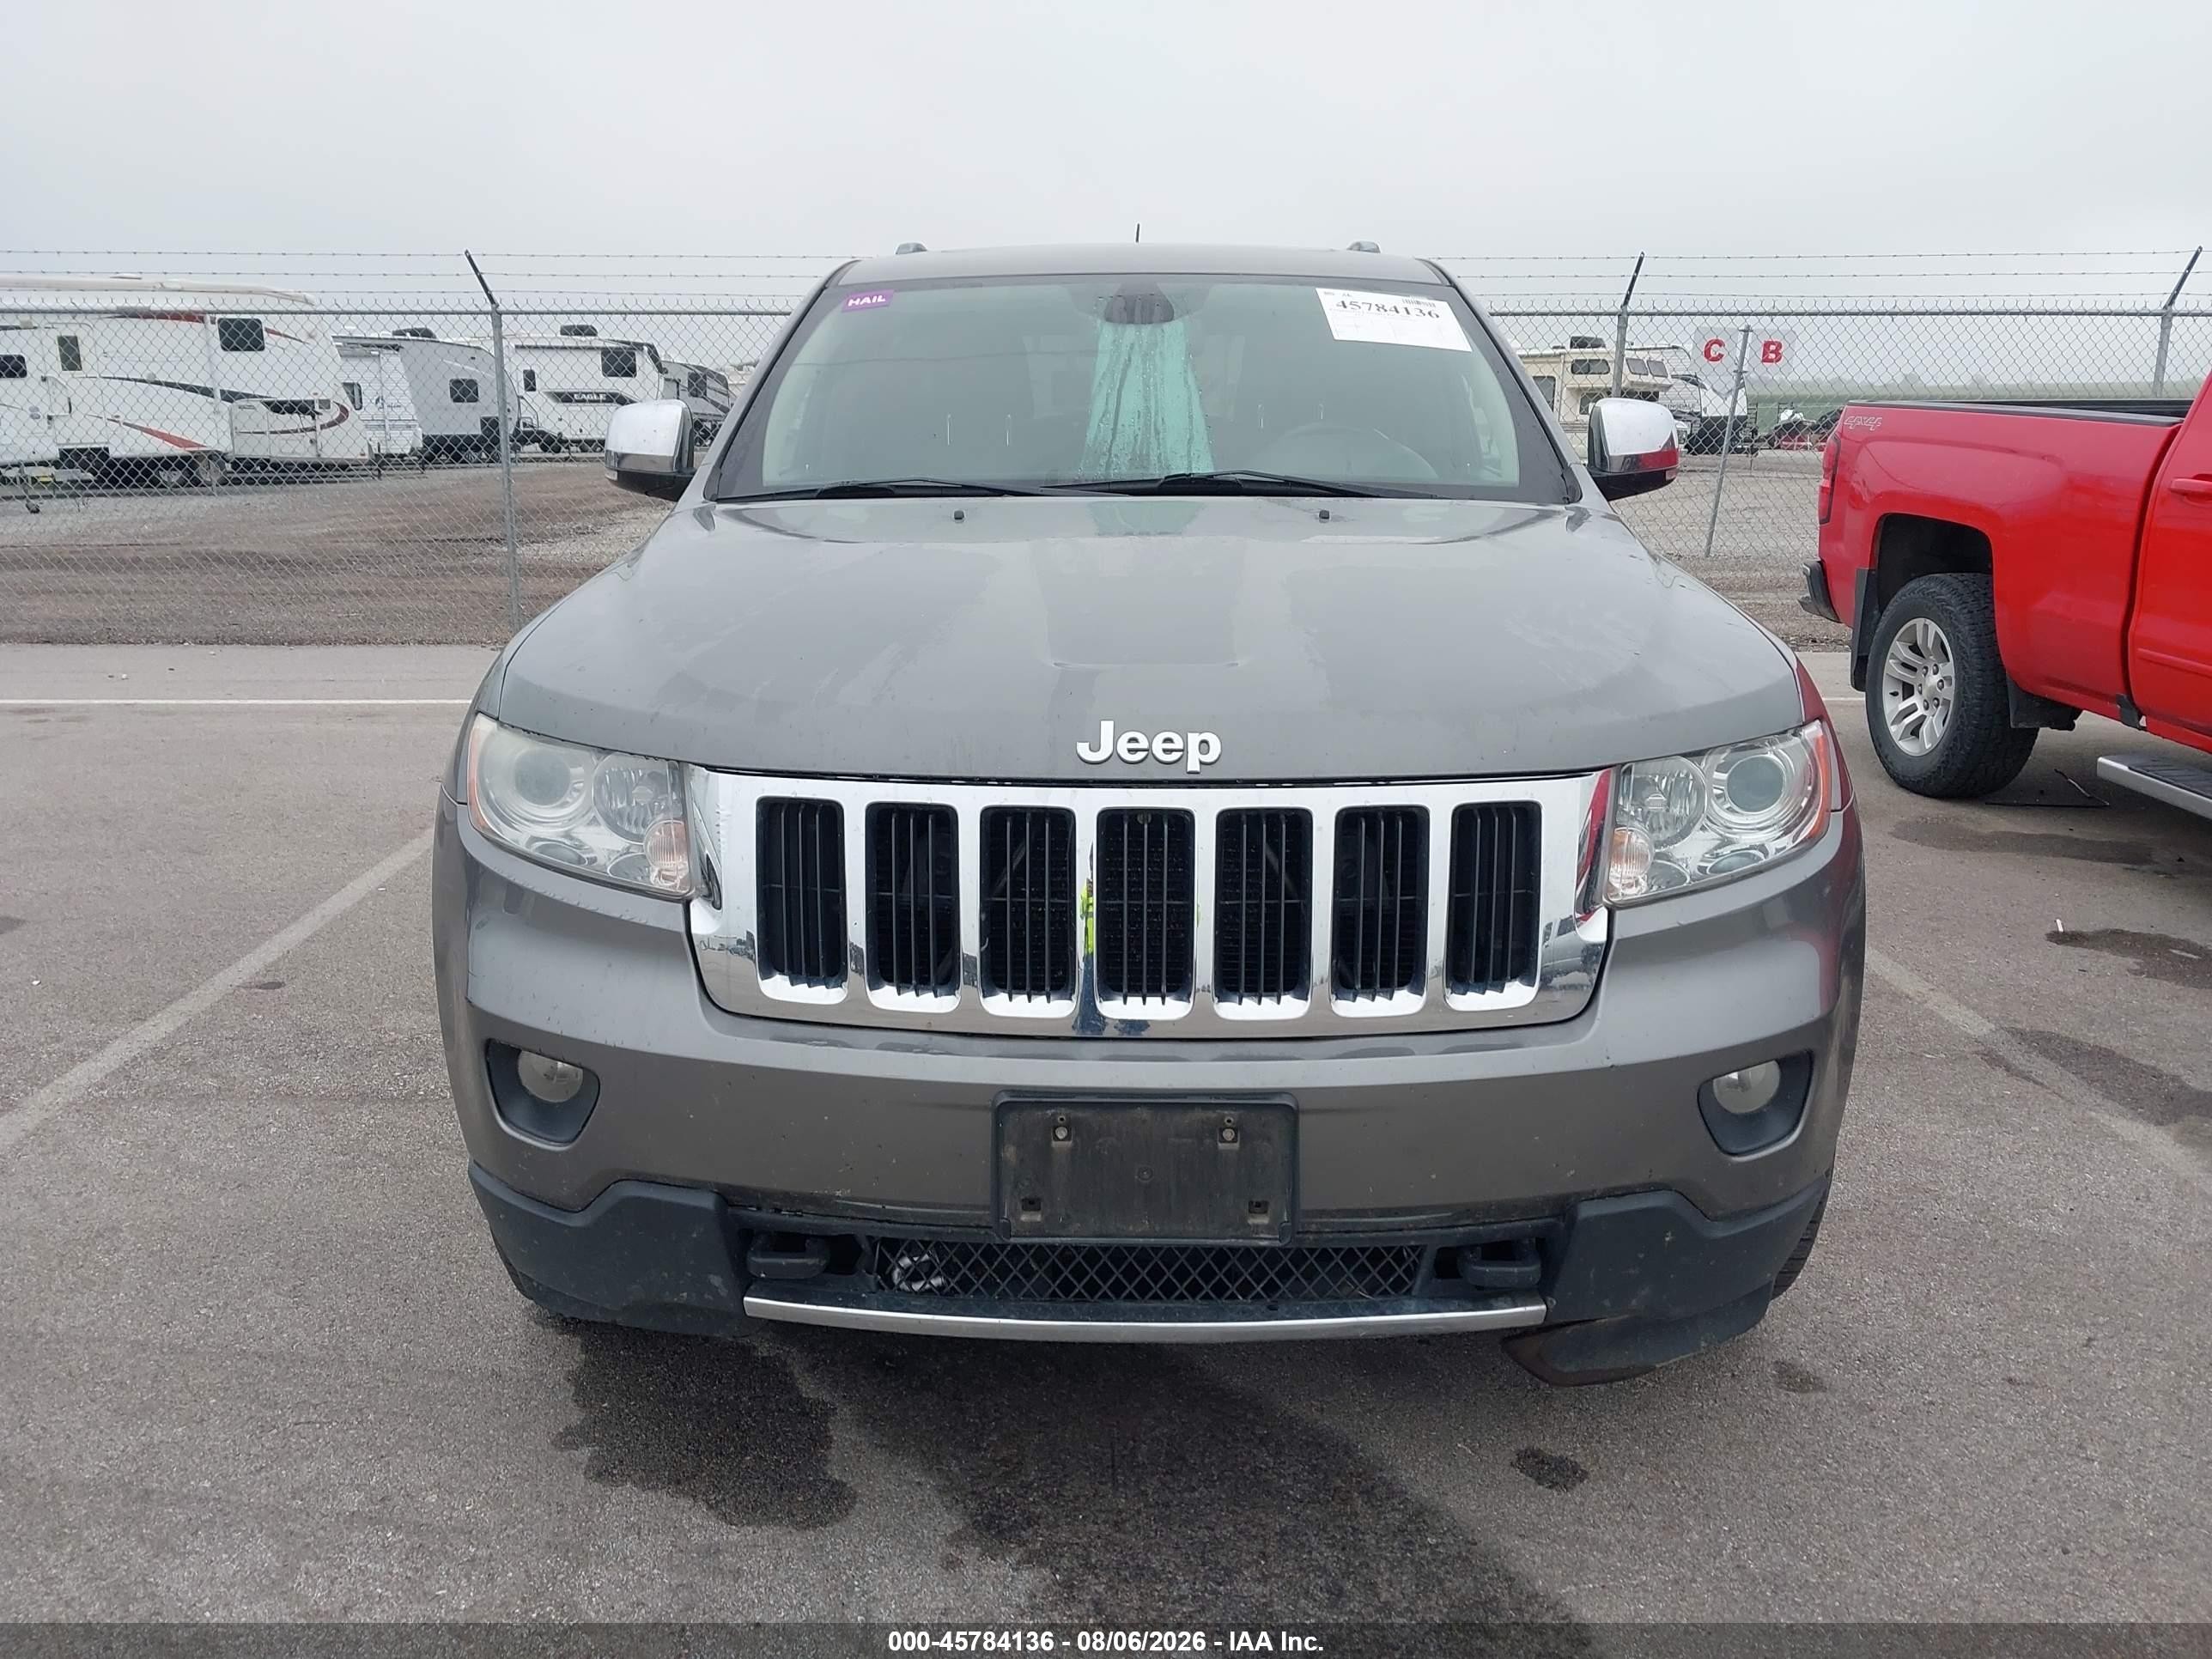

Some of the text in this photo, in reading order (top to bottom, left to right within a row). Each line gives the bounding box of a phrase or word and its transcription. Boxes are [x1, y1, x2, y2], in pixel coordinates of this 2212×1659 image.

[848, 295, 886, 307] HAIL
[1336, 300, 1440, 319] 45784136
[1704, 337, 1726, 362] C
[1761, 340, 1784, 363] B
[1076, 720, 1221, 775] Jeep
